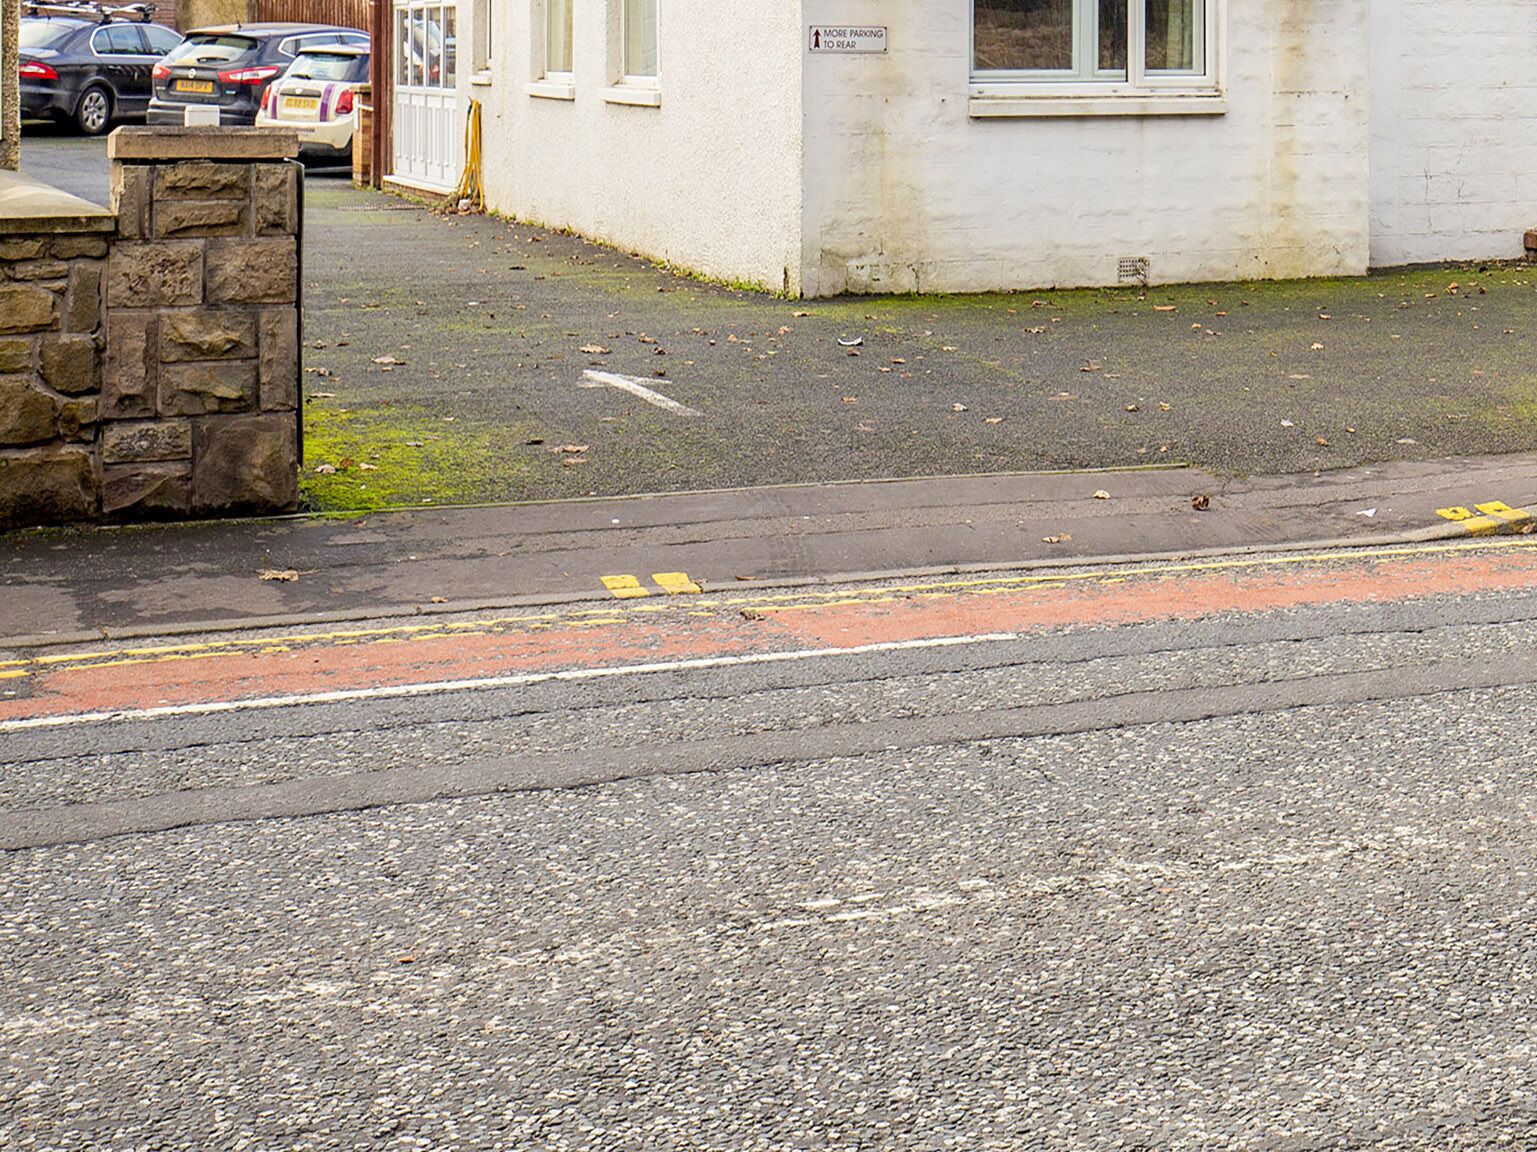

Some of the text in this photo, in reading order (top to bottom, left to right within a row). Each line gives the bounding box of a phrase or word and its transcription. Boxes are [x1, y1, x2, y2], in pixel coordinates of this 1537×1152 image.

[823, 29, 884, 38] MORE PARKING
[823, 40, 856, 49] TO REAR
